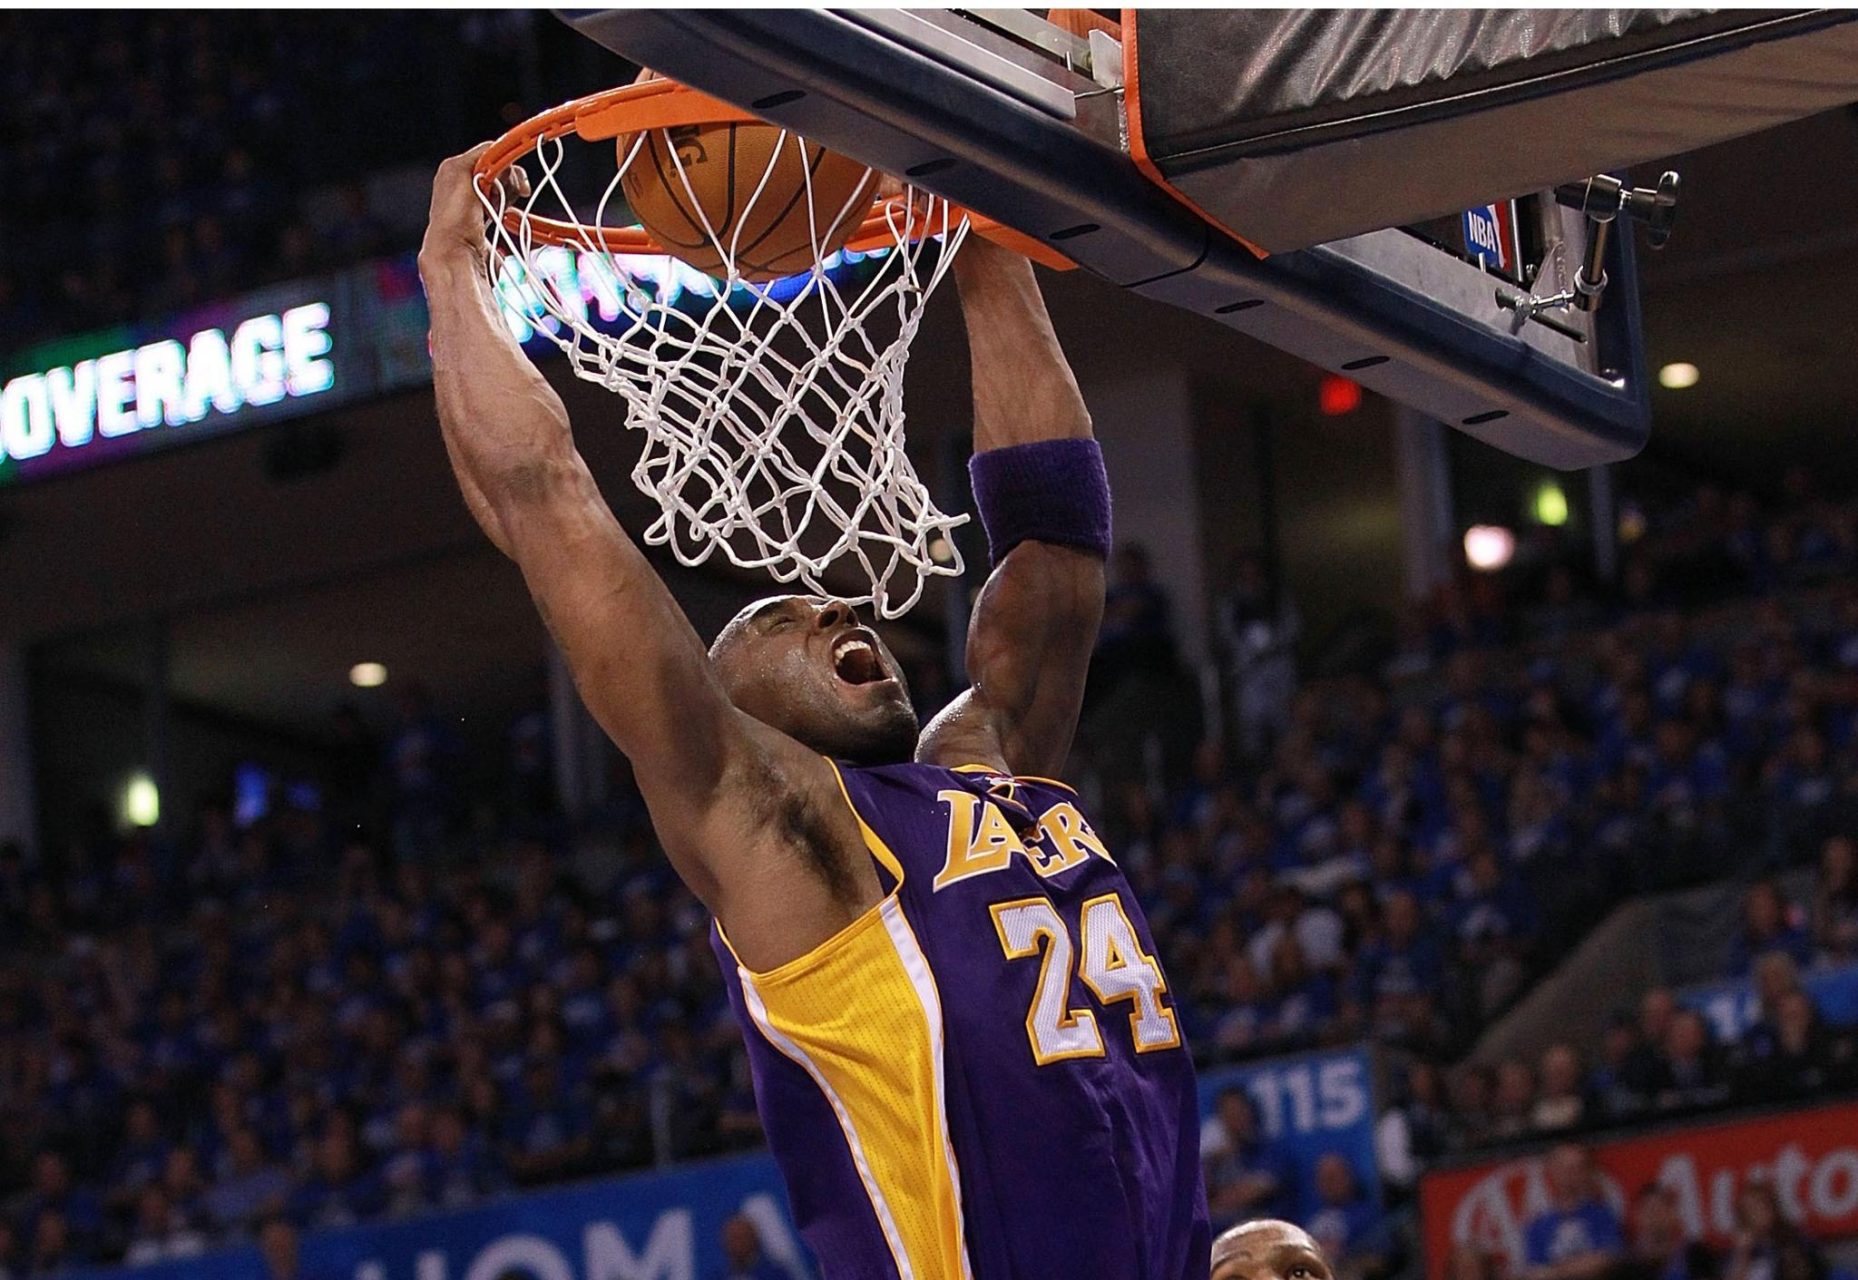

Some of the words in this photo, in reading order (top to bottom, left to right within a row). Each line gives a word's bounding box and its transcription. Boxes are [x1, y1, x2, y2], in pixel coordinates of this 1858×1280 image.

[1467, 210, 1497, 253] NBA
[0, 302, 335, 464] OVERAGE
[989, 892, 1181, 1066] 24
[1248, 1056, 1367, 1137] 115
